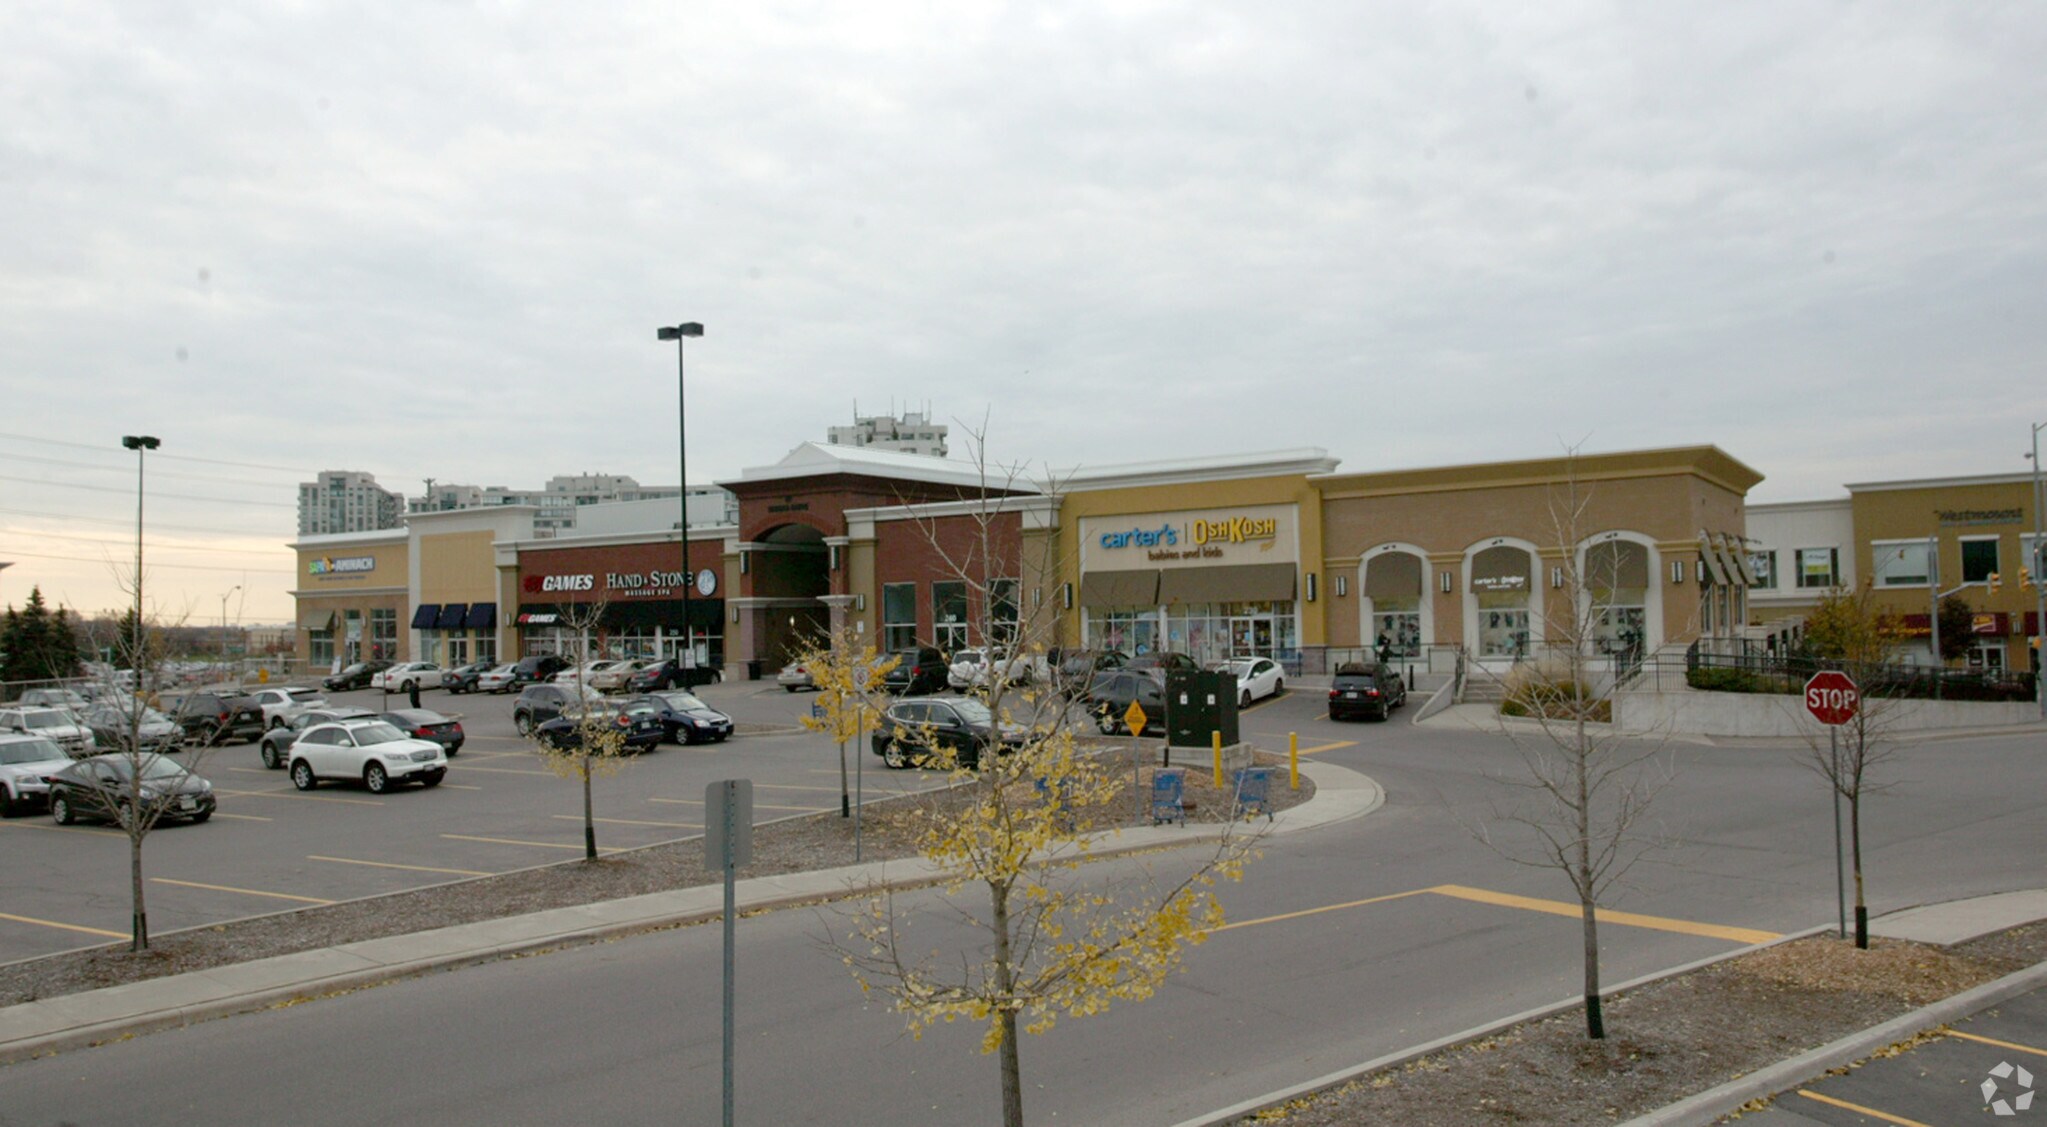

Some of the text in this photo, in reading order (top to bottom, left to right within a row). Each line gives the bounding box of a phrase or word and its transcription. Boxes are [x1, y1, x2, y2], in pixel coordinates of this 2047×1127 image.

[1100, 524, 1177, 549] carter's
[1148, 547, 1224, 561] babies and kids
[542, 574, 594, 591] GAMES
[606, 573, 643, 589] HAND
[528, 614, 557, 623] GAMES
[1809, 688, 1856, 710] STOP
